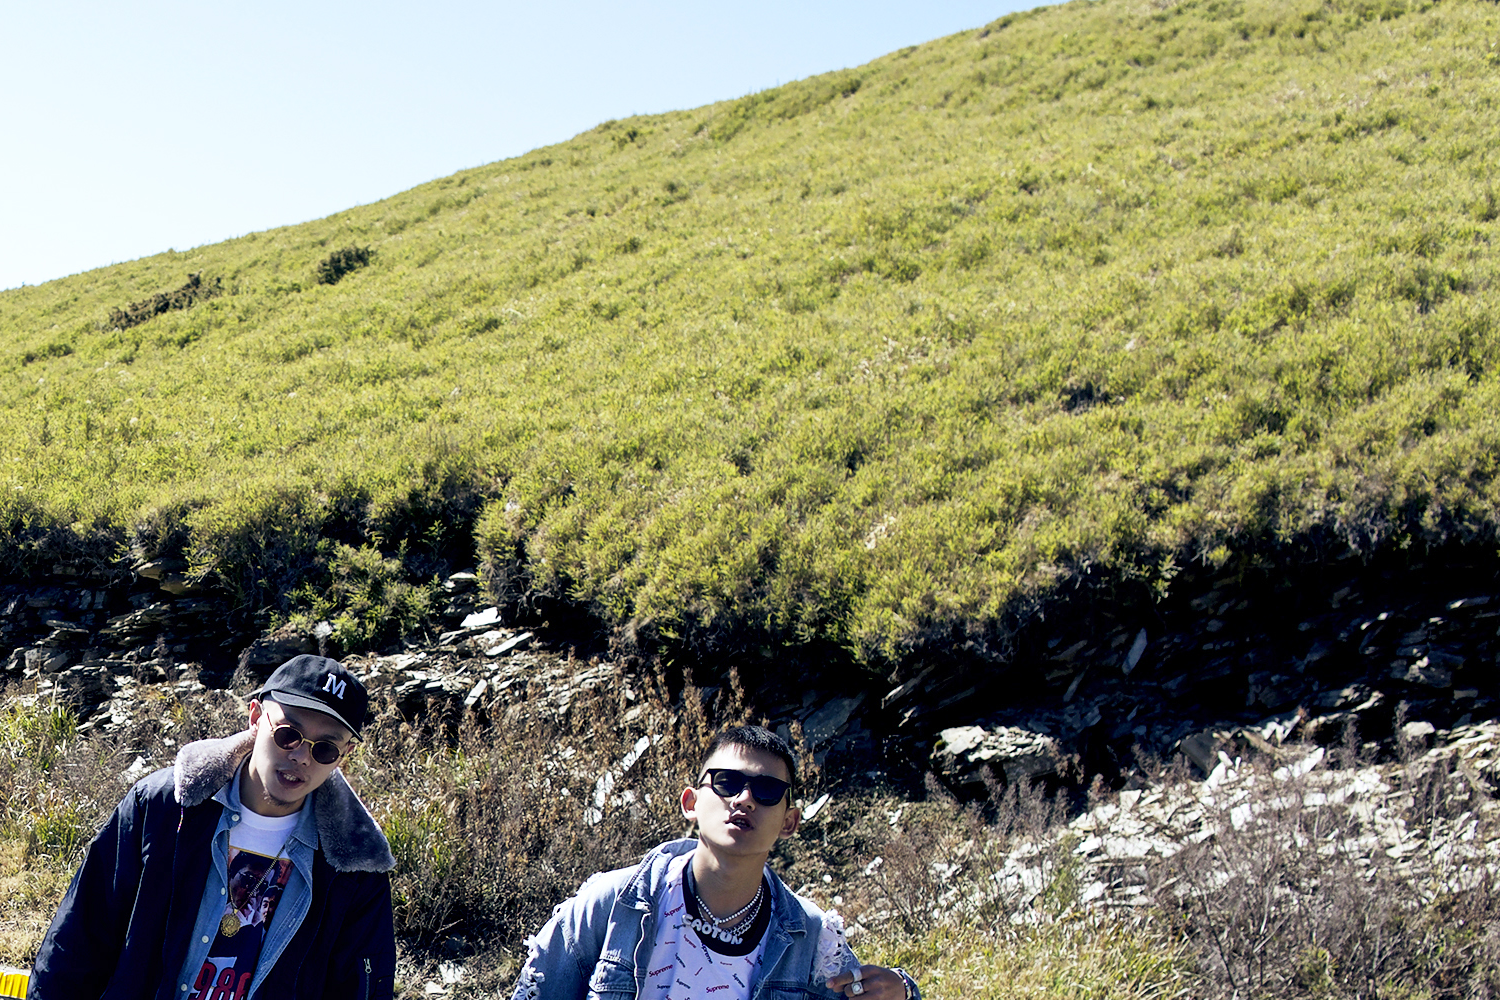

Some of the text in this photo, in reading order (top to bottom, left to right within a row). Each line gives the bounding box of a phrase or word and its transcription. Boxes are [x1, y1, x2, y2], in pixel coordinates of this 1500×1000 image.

[322, 673, 347, 699] M
[664, 903, 684, 918] Supreme
[649, 964, 673, 977] Supreme
[706, 985, 729, 993] Supreme
